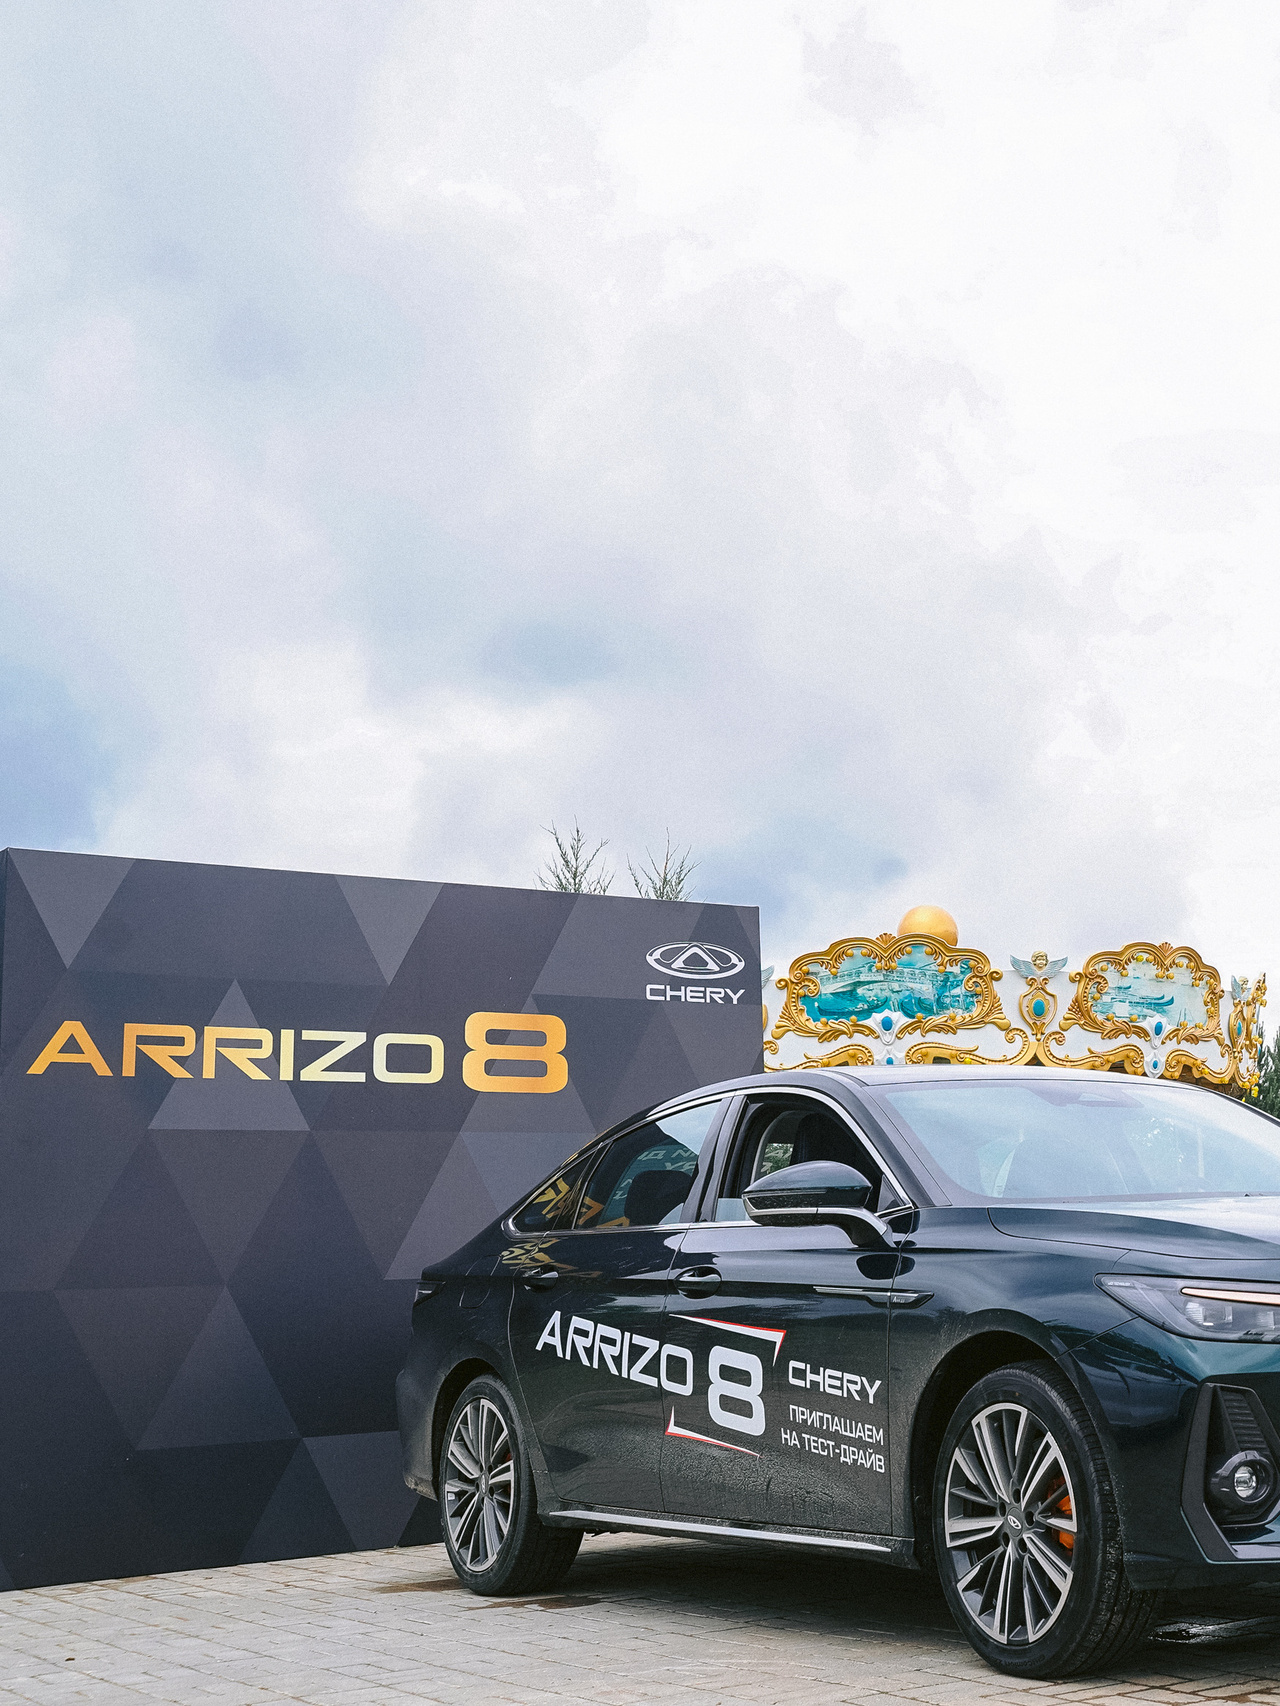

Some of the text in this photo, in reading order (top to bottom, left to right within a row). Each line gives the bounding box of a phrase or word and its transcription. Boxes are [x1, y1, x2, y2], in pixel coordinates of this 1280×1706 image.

[646, 984, 746, 1004] CHERY
[26, 1011, 569, 1094] ARRIZO 8
[535, 1310, 766, 1436] ARRIZO 8
[788, 1360, 882, 1404] CHERY
[789, 1404, 884, 1446] ПРИГЛАШАЕМ
[781, 1427, 886, 1473] НА ТЕСТ-ДРАЙВ
